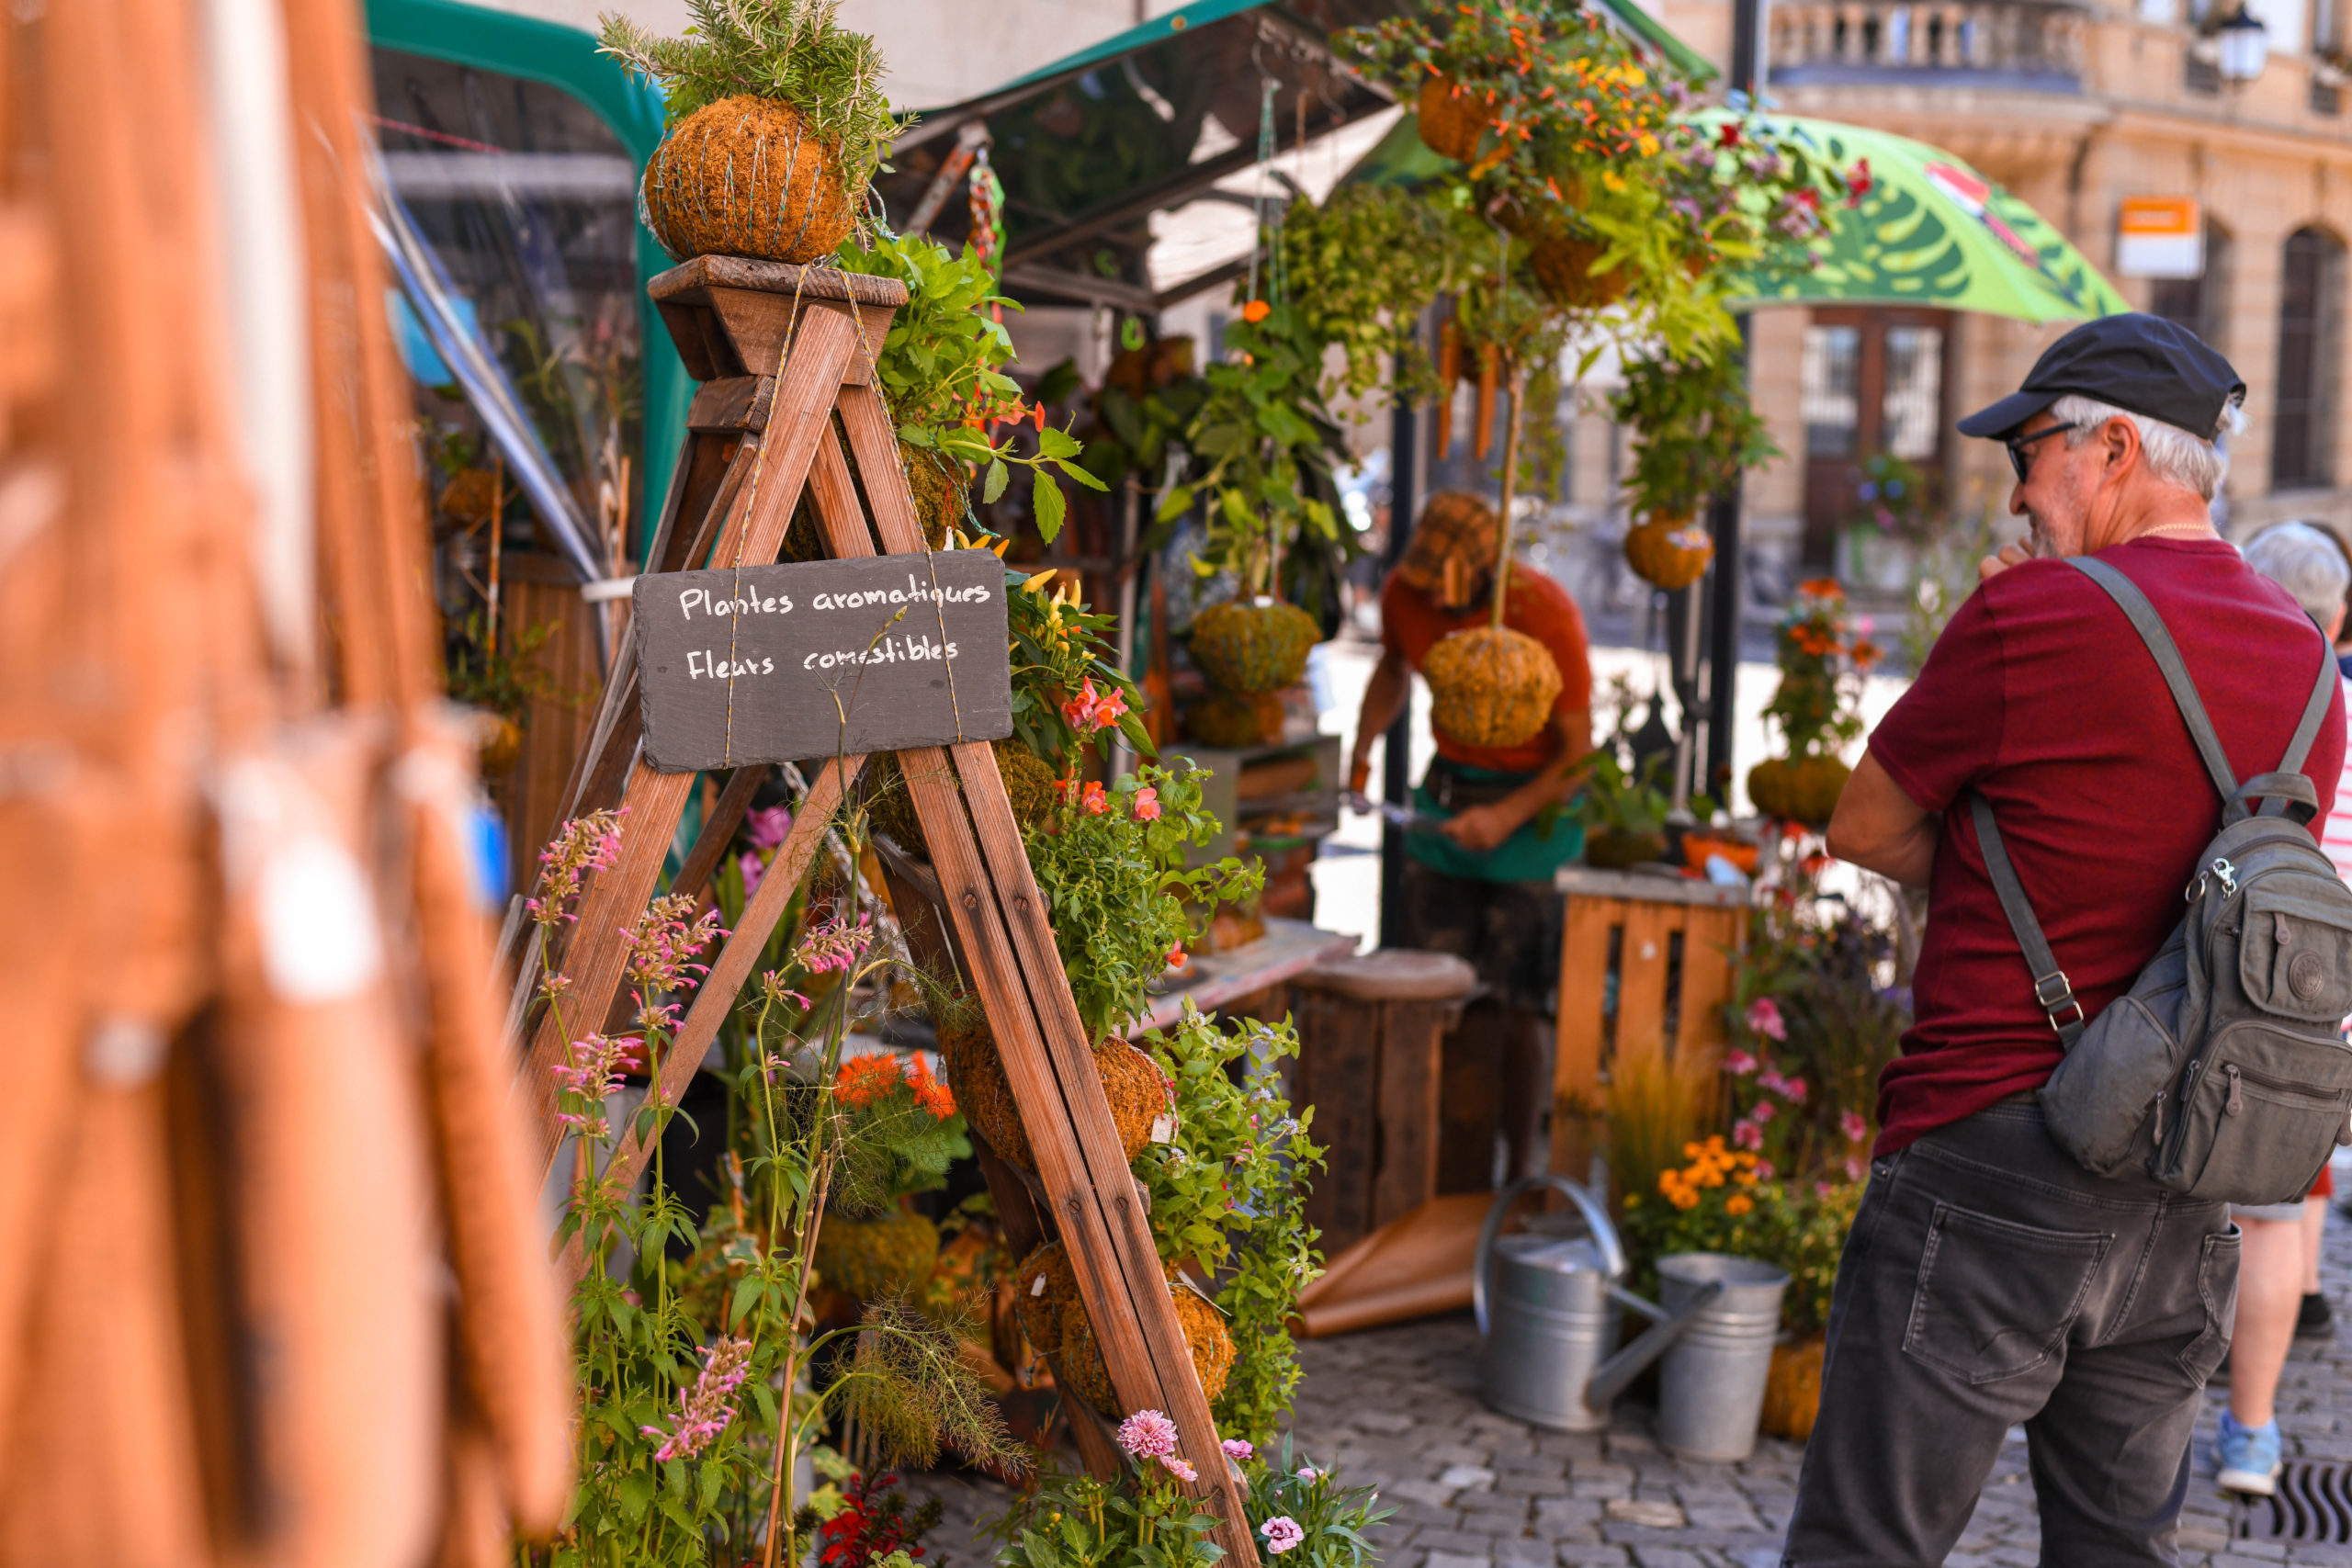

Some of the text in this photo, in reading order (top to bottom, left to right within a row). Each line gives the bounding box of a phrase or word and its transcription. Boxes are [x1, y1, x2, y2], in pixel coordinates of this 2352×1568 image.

[679, 574, 991, 620] Plantes aromatiques
[686, 635, 958, 680] Fleurs comestibles
